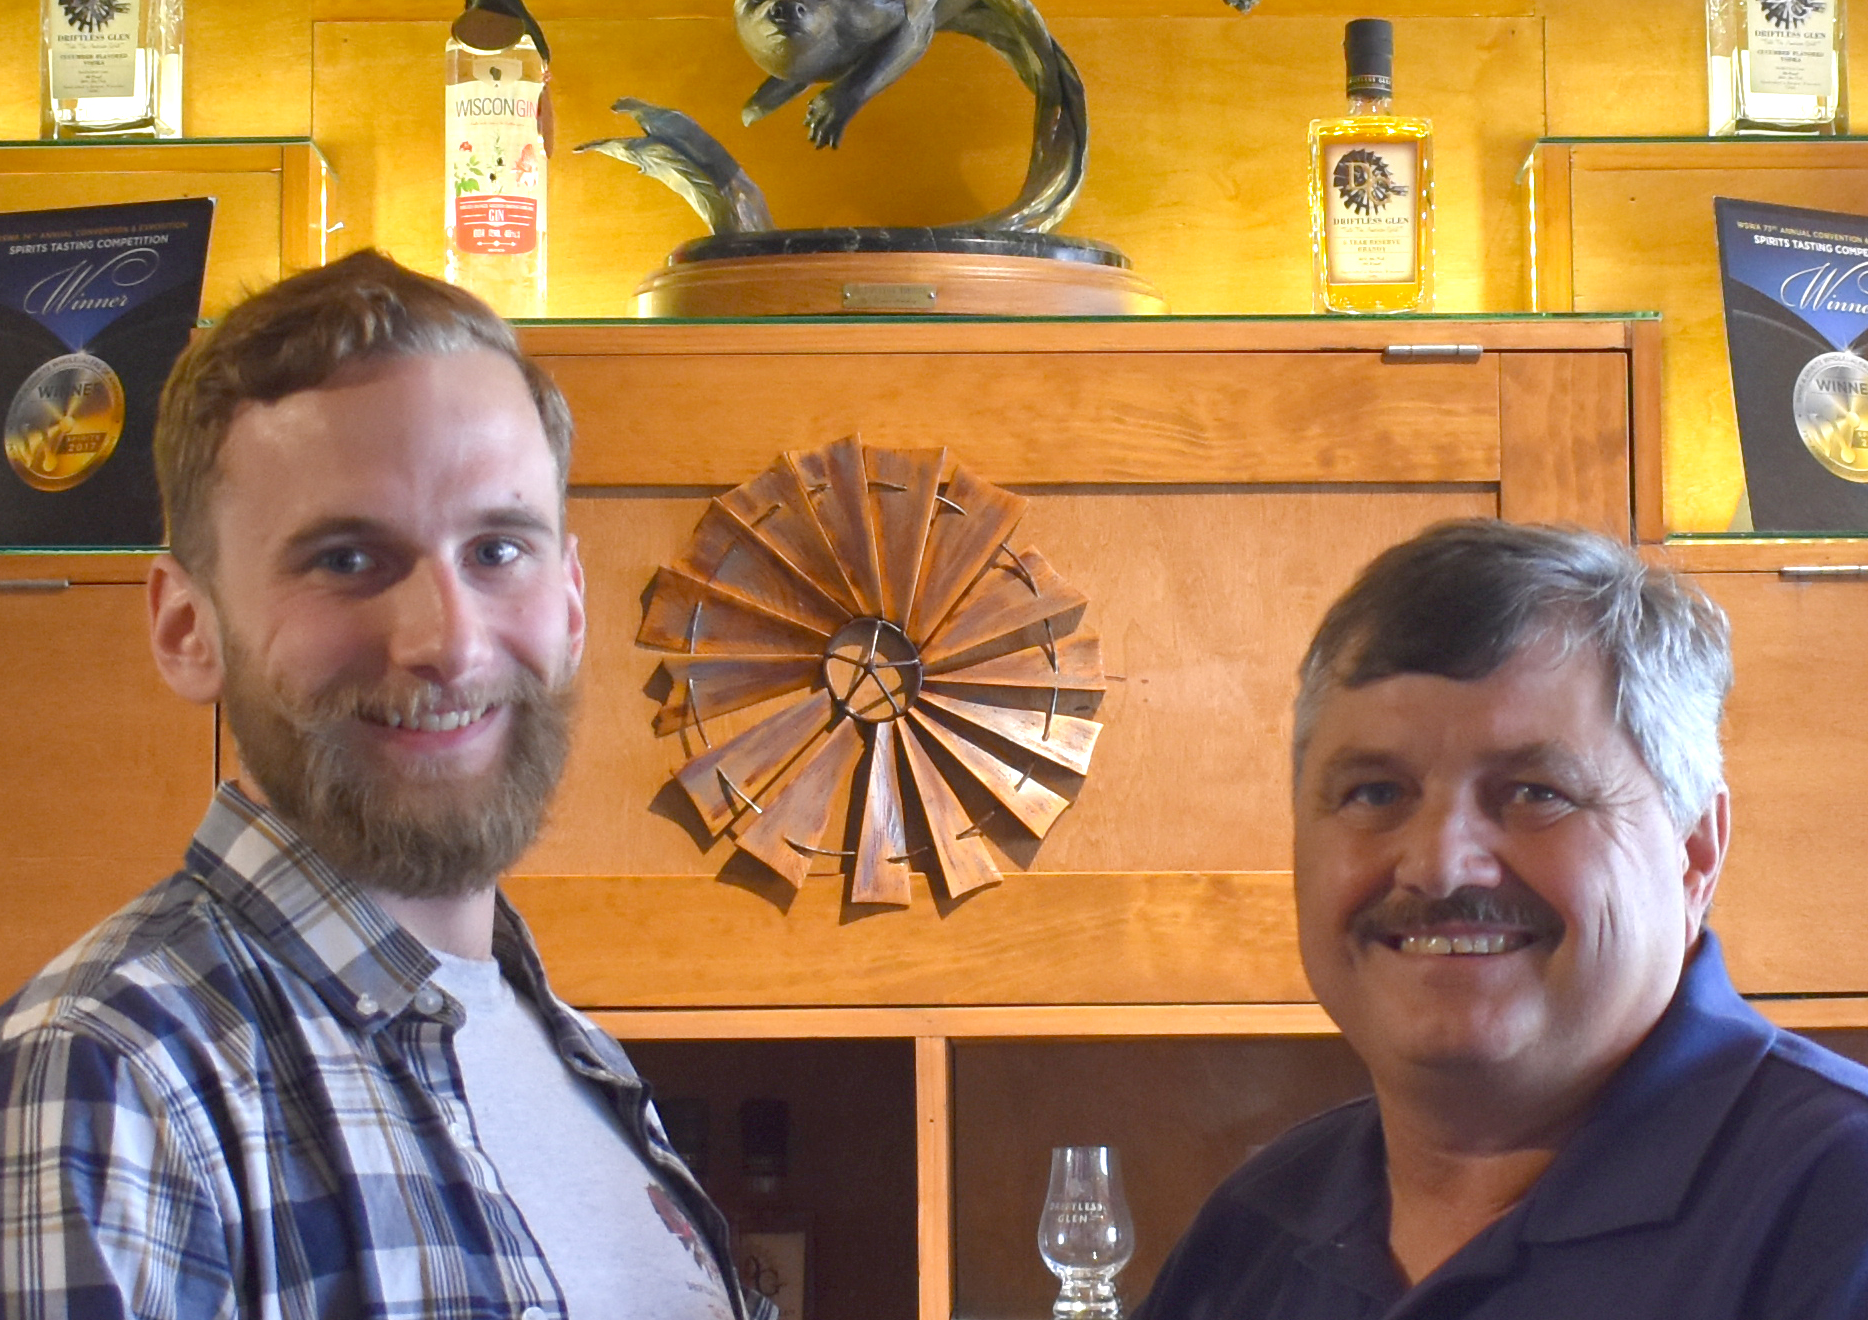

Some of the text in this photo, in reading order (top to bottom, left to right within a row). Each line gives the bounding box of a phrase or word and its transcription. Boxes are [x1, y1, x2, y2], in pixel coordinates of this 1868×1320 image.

[455, 97, 538, 118] WISCONGIN
[488, 209, 505, 222] GIN
[9, 234, 170, 256] SPIRITS TASTING COMPETITION
[1753, 234, 1790, 248] SPIRITS
[1792, 239, 1833, 253] TASTING
[23, 247, 161, 316] Winner
[1057, 1214, 1088, 1223] GLEN
